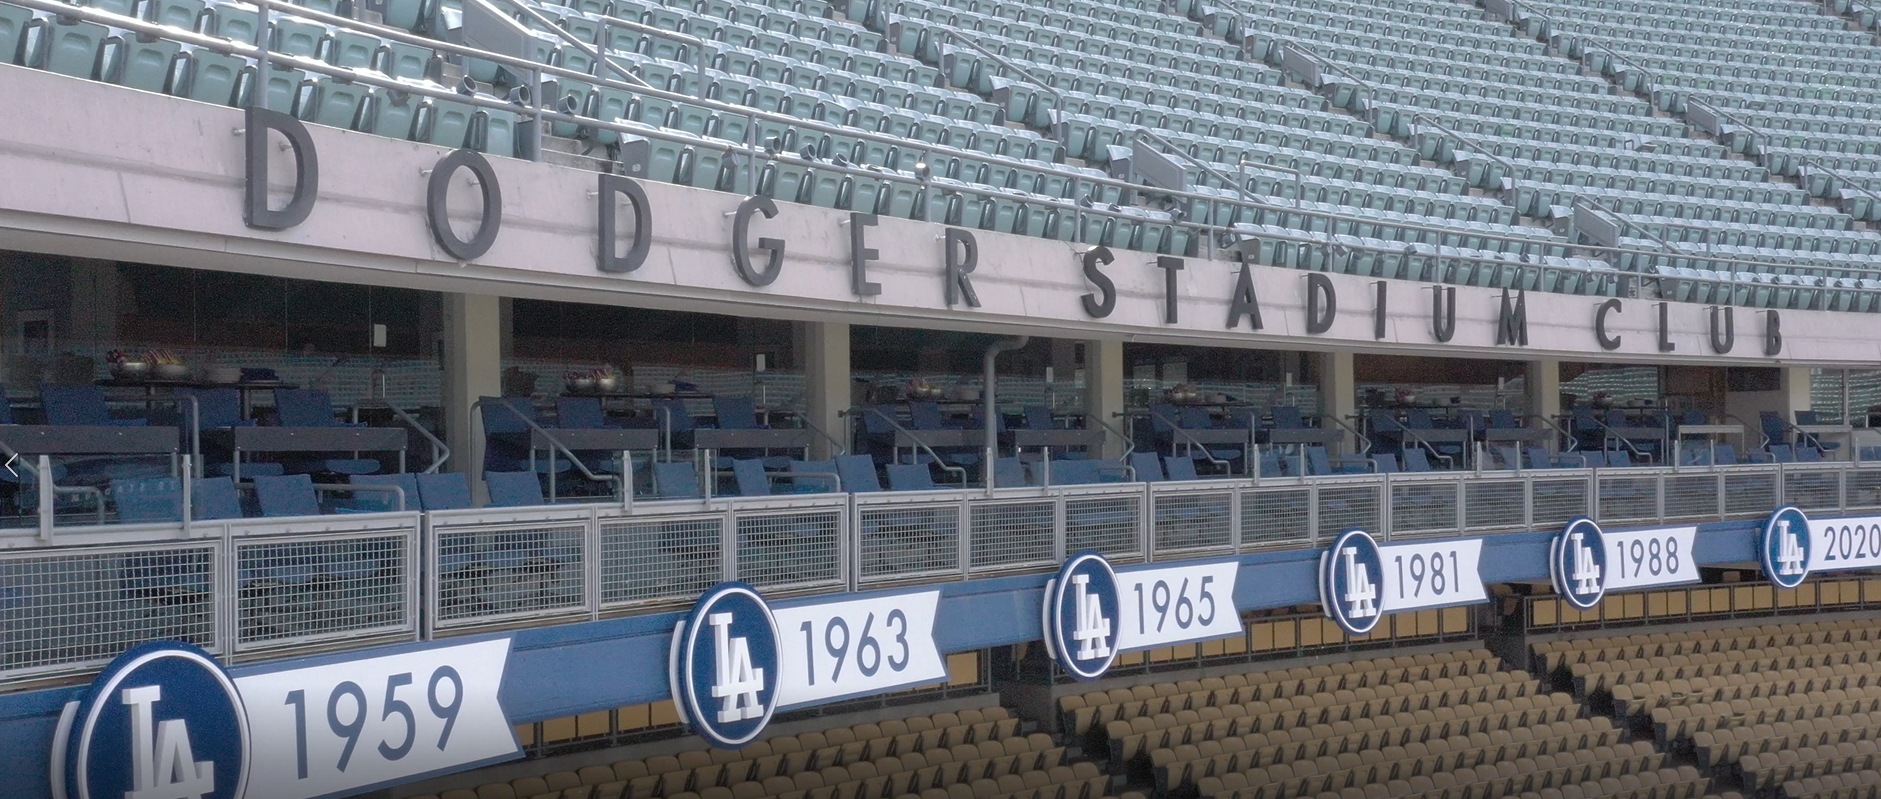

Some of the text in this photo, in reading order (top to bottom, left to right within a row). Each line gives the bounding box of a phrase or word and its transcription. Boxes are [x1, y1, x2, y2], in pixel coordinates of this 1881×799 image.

[245, 106, 1783, 356] DODGER STADIUM CLUB
[1617, 537, 1679, 578] 1988
[1824, 523, 1881, 561] 2020
[1133, 575, 1216, 635] 1965
[1394, 550, 1461, 600] 1981
[799, 608, 910, 686] 1963
[284, 665, 464, 779] 1959
